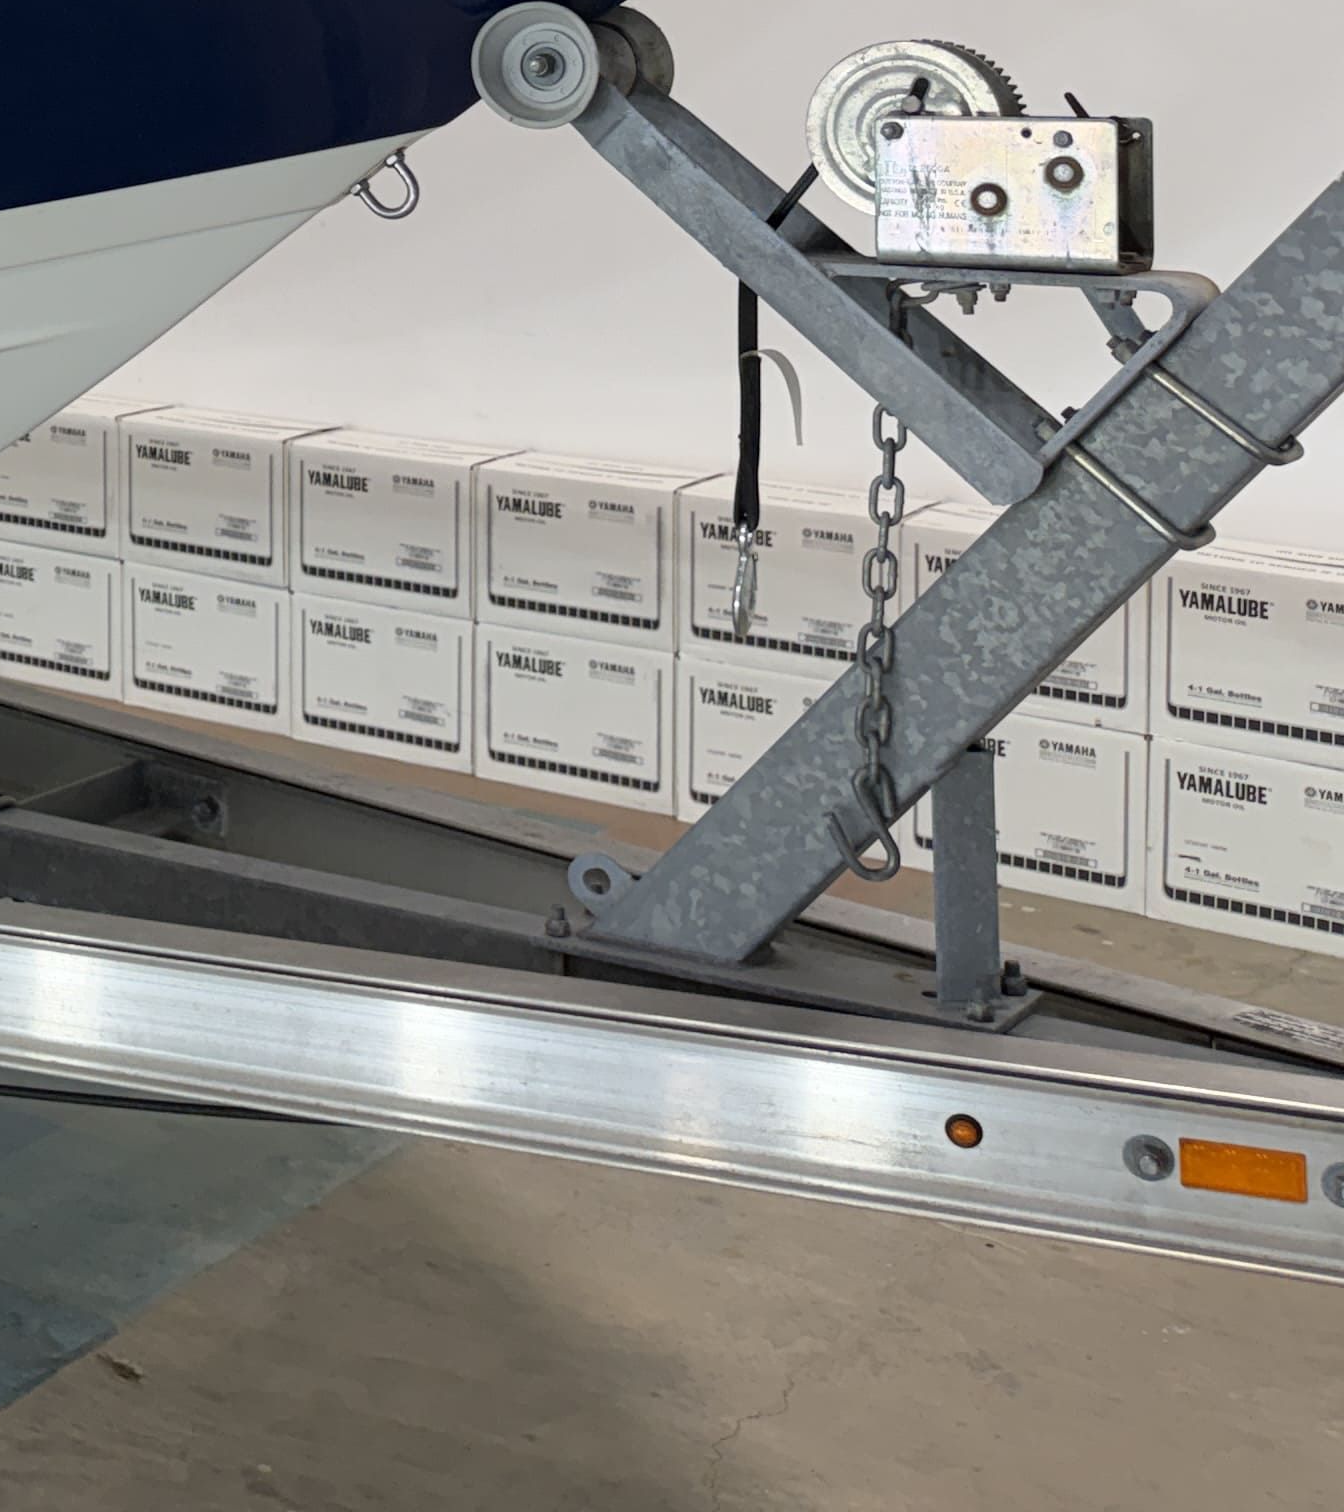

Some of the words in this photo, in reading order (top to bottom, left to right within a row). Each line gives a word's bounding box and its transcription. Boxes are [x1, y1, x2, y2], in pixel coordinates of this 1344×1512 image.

[136, 444, 191, 465] YAMALUBE
[308, 470, 368, 492] YAMALUBE
[496, 495, 562, 519] YAMALUBE
[700, 522, 773, 547] YAMABE
[814, 529, 853, 543] YAMAHA
[138, 587, 195, 610] YAMALUBE
[1179, 589, 1269, 620] YAMALUBE
[310, 619, 371, 644] YAMALUBE
[496, 651, 563, 677] YAMALUBE
[699, 687, 774, 715] YAMALUBE
[1051, 741, 1096, 758] YAMAHA
[1176, 771, 1268, 805] YAMALUBE
